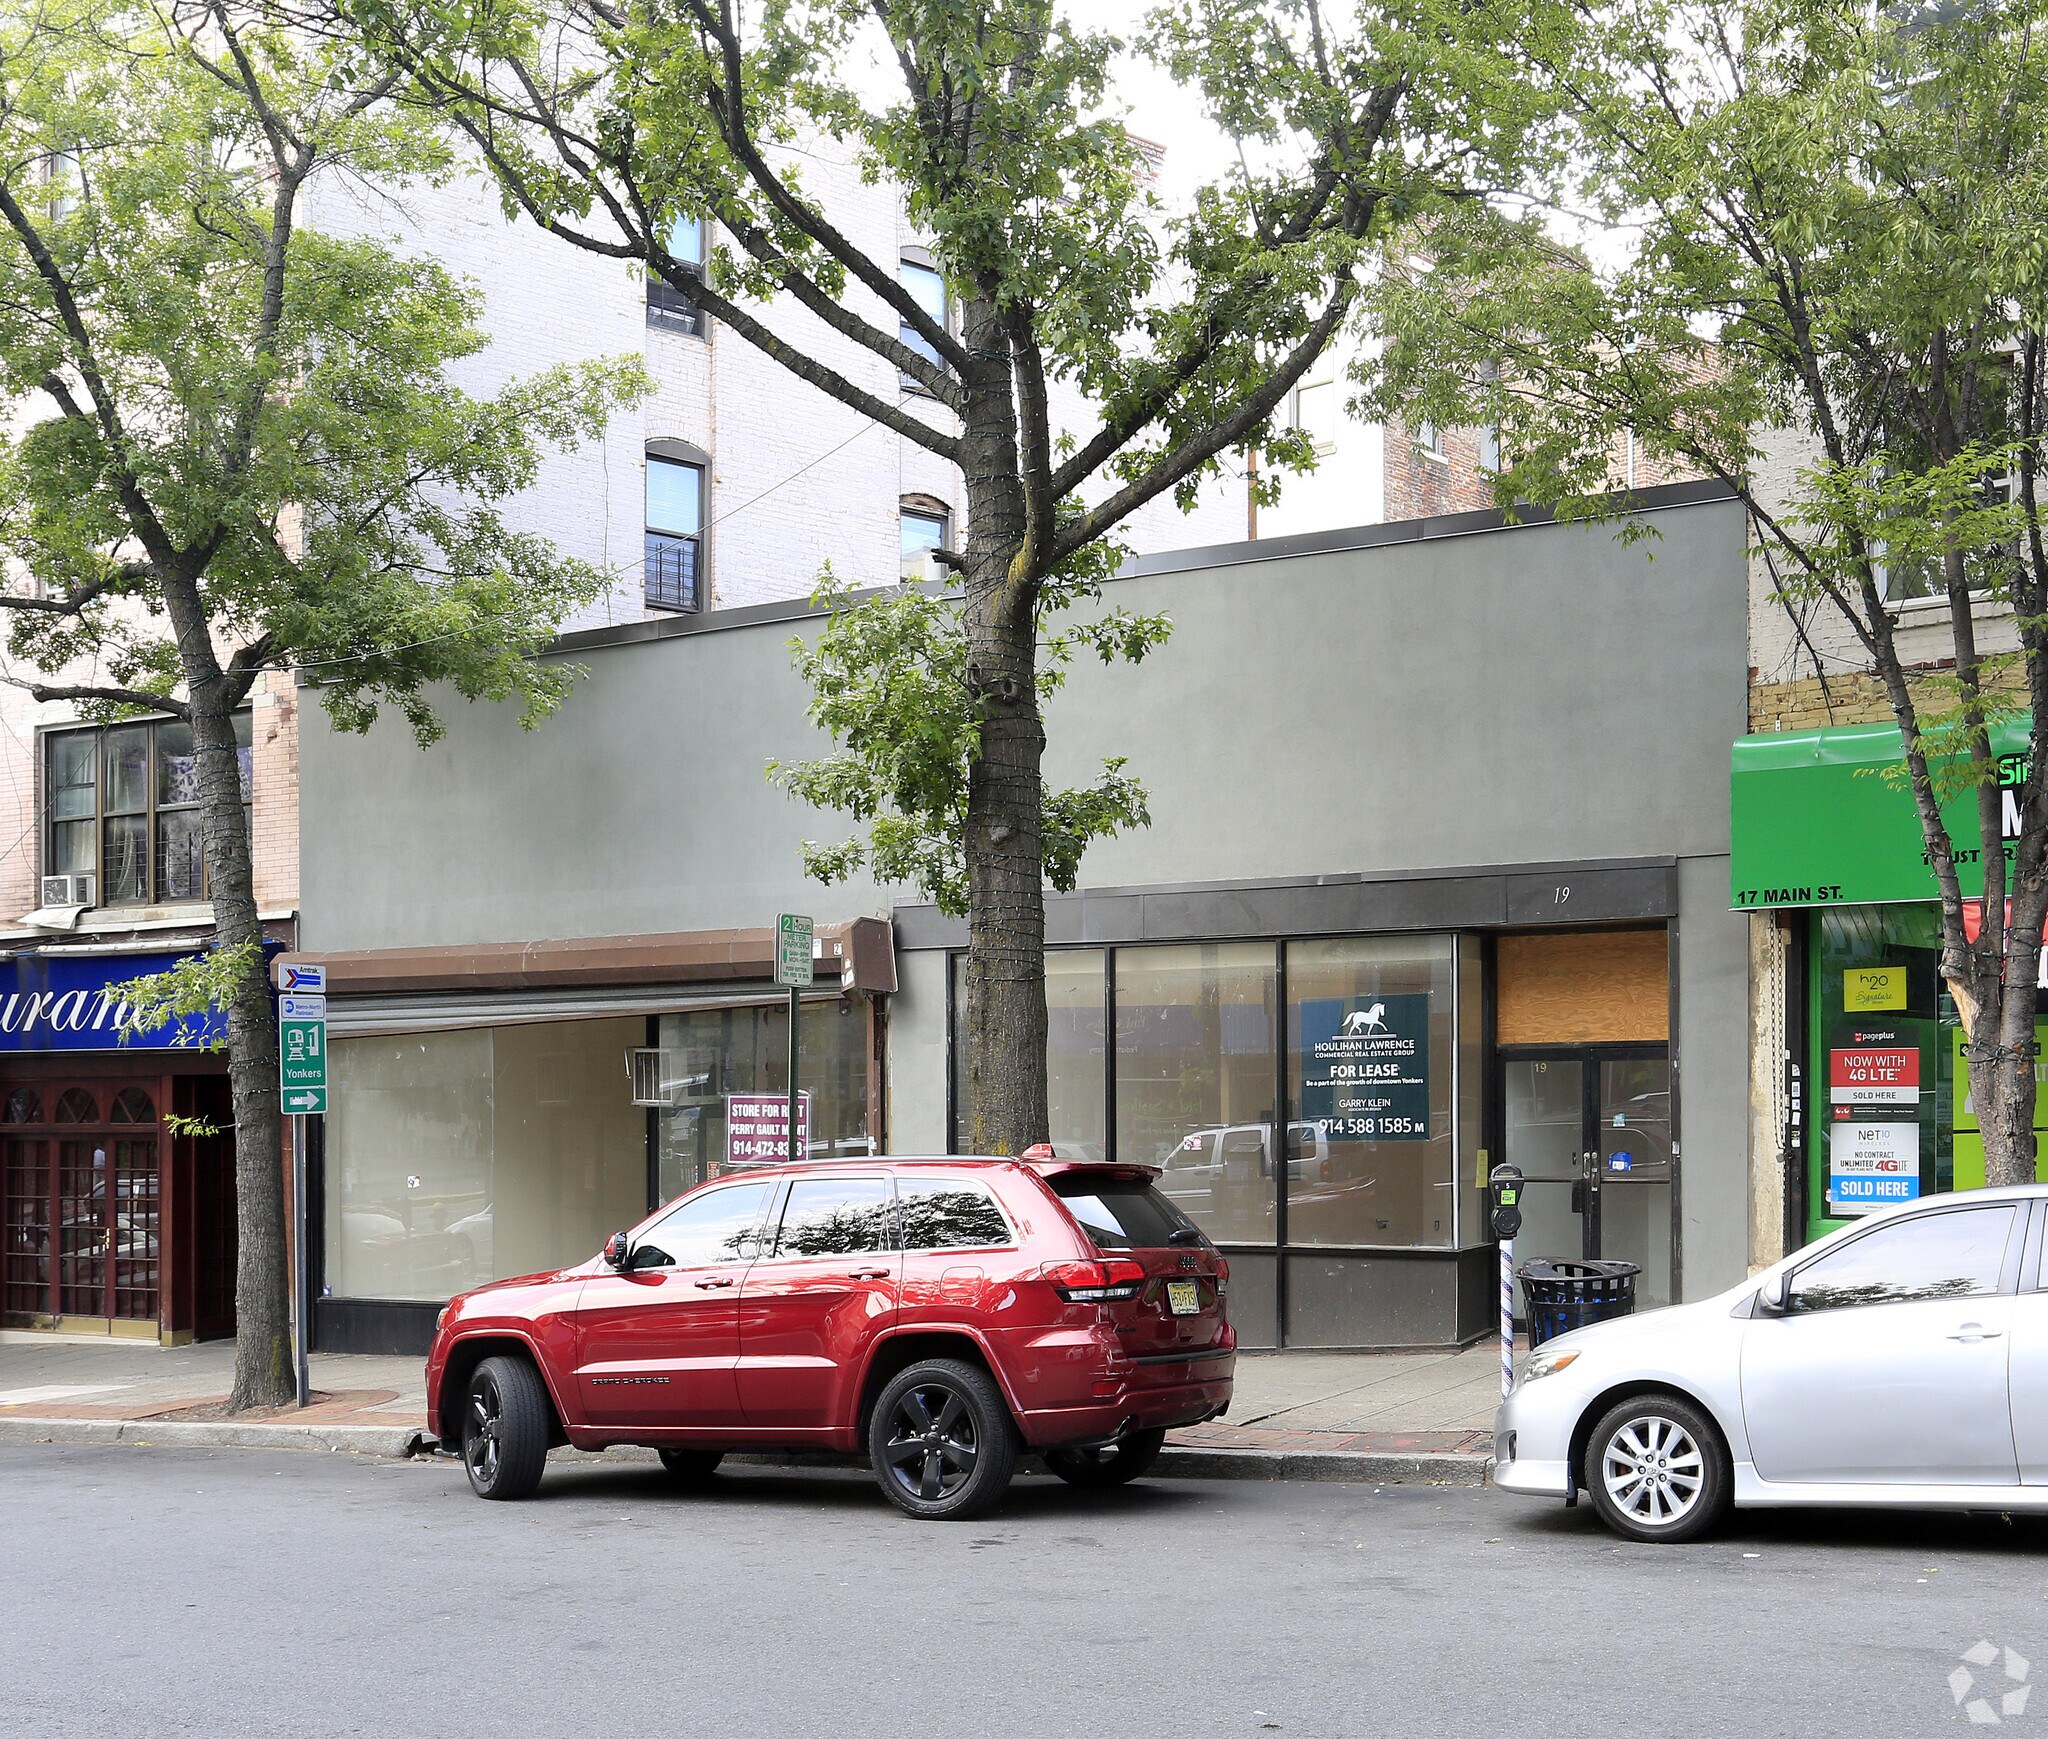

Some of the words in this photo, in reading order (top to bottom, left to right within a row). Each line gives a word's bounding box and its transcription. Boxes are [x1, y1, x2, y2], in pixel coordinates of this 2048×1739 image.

[1921, 850, 1981, 866] TUST
[1554, 886, 1571, 904] 19
[1737, 890, 1758, 904] 17
[1763, 887, 1811, 904] MAIN
[1817, 886, 1844, 900] ST.
[783, 917, 791, 931] 2
[793, 923, 811, 932] HOUR
[786, 933, 807, 942] METER
[784, 940, 810, 949] PARKING
[299, 966, 319, 974] Amtrak
[0, 974, 158, 1033] uran
[1856, 990, 1893, 1005] Signature
[1862, 1032, 1895, 1042] pageplus
[1315, 1041, 1362, 1052] HOULIHAN
[1364, 1039, 1415, 1050] LAWRENCE
[1315, 1051, 1354, 1059] COMMERCIAL
[1844, 1056, 1873, 1067] NOW
[1875, 1055, 1906, 1067] WITH
[286, 1068, 322, 1078] Yonkers
[1330, 1065, 1356, 1078] FOR
[1359, 1064, 1399, 1077] LEASE
[1534, 1063, 1547, 1073] 19
[1849, 1068, 1867, 1081] 4G
[1875, 1091, 1896, 1099] HERE
[1339, 1098, 1367, 1108] GARRY
[1368, 1098, 1391, 1107] KLEIN
[732, 1104, 760, 1117] STORE
[762, 1104, 779, 1118] FOR
[730, 1123, 755, 1135] PERRY
[756, 1124, 780, 1135] GAULT
[1319, 1118, 1344, 1134] 914
[1348, 1118, 1374, 1133] 588
[1378, 1117, 1412, 1133] 1585
[1414, 1123, 1424, 1133] M
[733, 1140, 802, 1157] 914-472-833
[1854, 1151, 1863, 1159] NO
[1864, 1151, 1894, 1159] CONTRACT
[1840, 1160, 1873, 1168] UNLIMITED
[1875, 1160, 1899, 1172] 4G
[1899, 1160, 1908, 1171] LTE
[1841, 1181, 1873, 1196] SOLD
[1876, 1181, 1909, 1197] HERE
